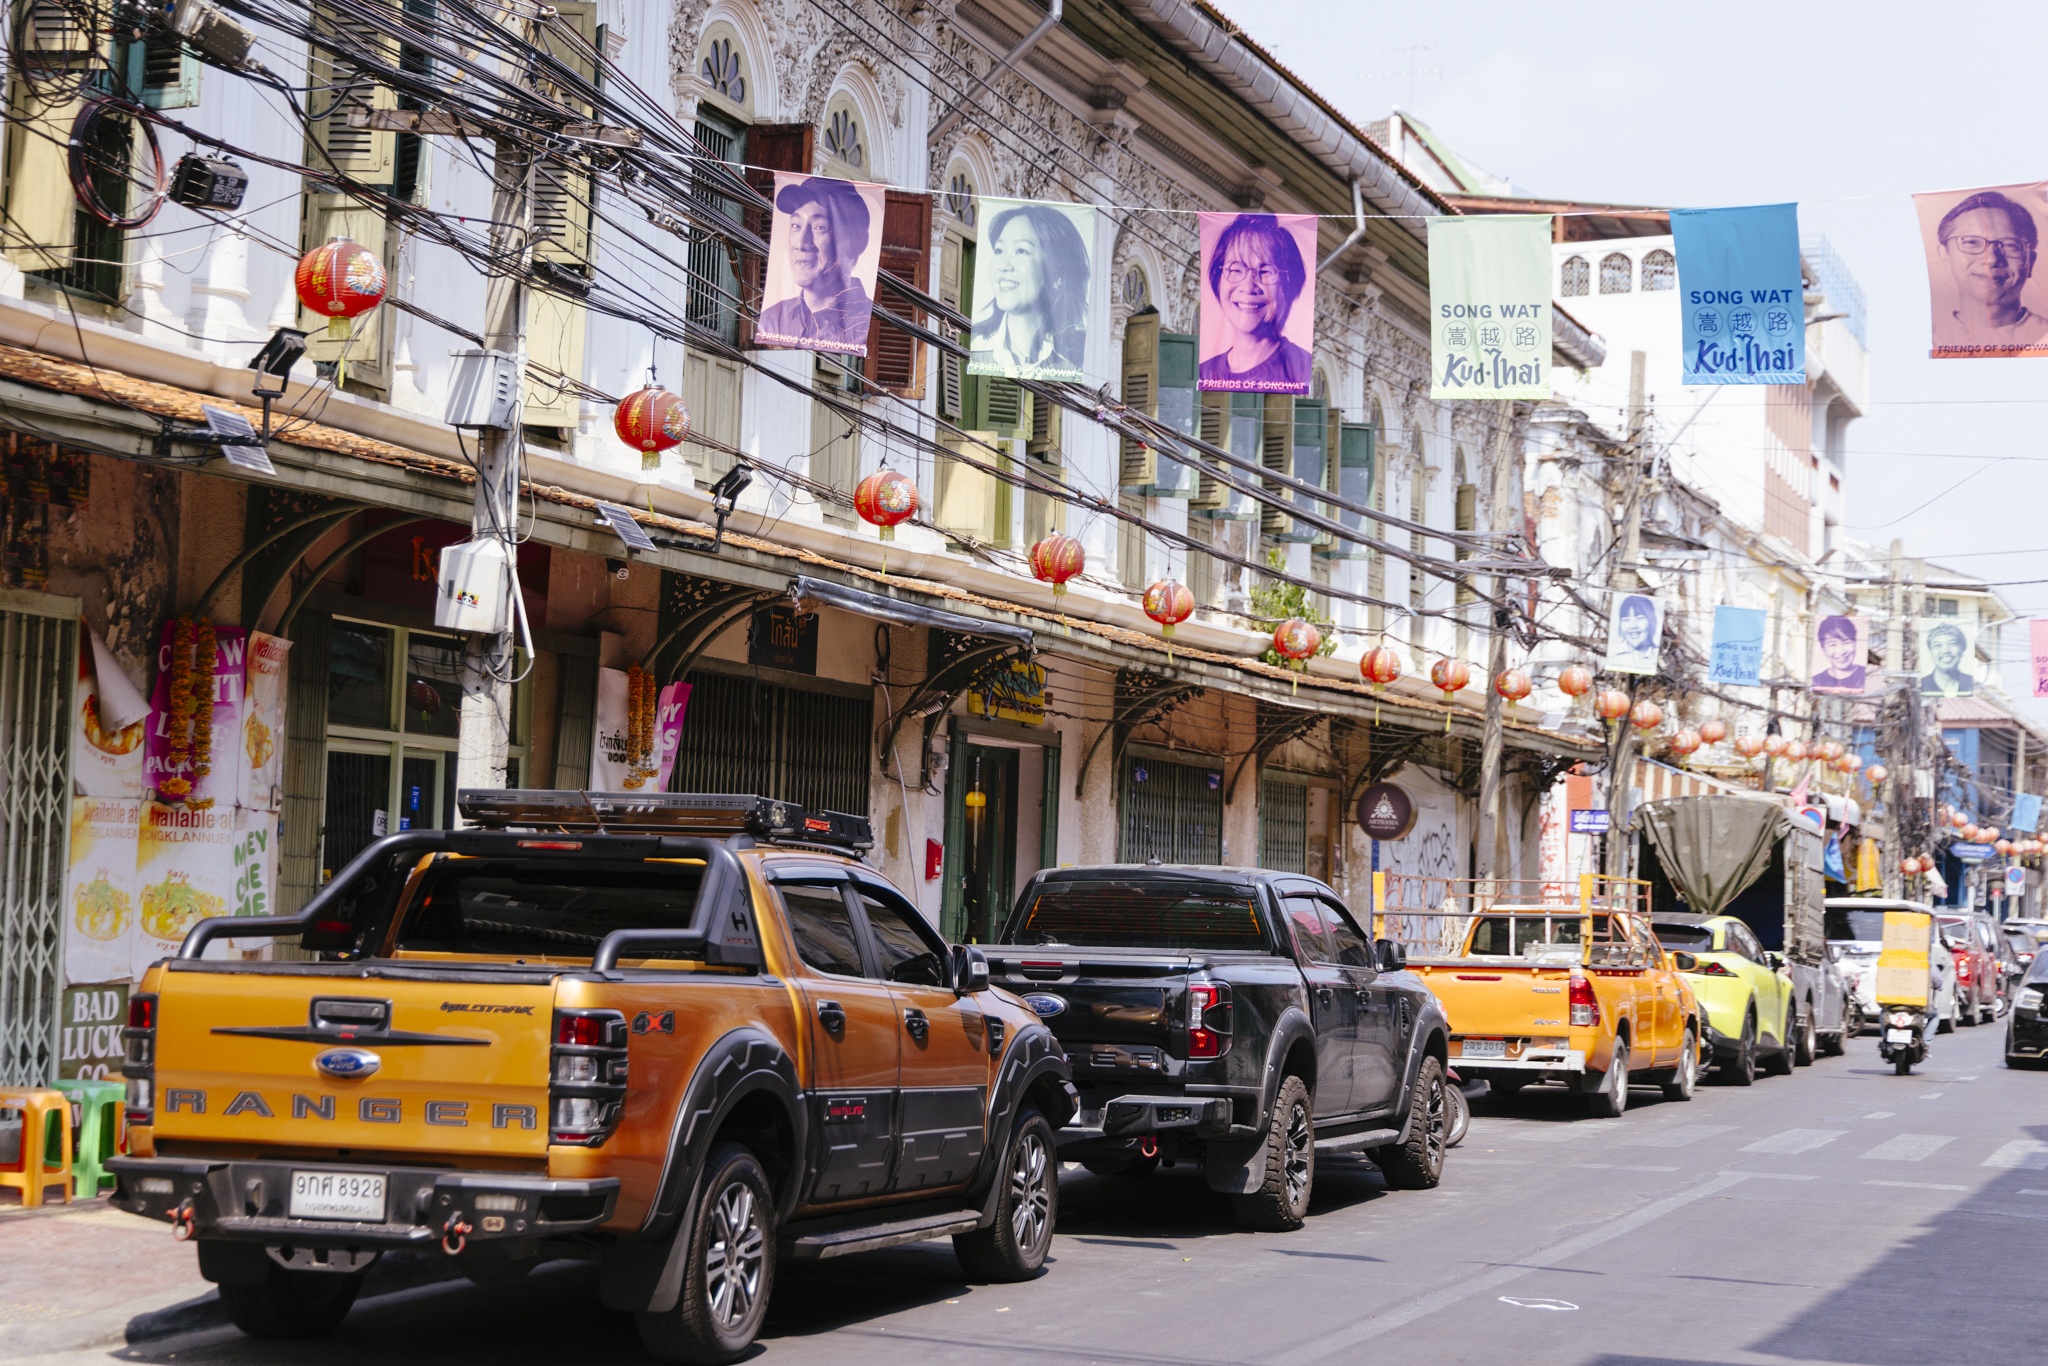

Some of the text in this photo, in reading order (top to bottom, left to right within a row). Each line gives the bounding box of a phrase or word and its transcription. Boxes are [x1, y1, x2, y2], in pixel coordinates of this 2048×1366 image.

[1690, 289, 1793, 304] SONG WAT
[1441, 304, 1541, 318] SONG WAT
[762, 332, 798, 344] FRIENDS
[800, 337, 813, 345] OF
[1938, 345, 1981, 353] FRIENDS
[1203, 379, 1304, 389] FRIENDS OF SONGWAT
[83, 801, 140, 825] Available at
[149, 806, 233, 830] Available at
[73, 991, 119, 1023] BAD
[63, 1025, 125, 1061] LUCK
[1484, 1042, 1505, 1051] 2012
[165, 1088, 538, 1130] RANGER
[339, 1177, 382, 1198] 8928
